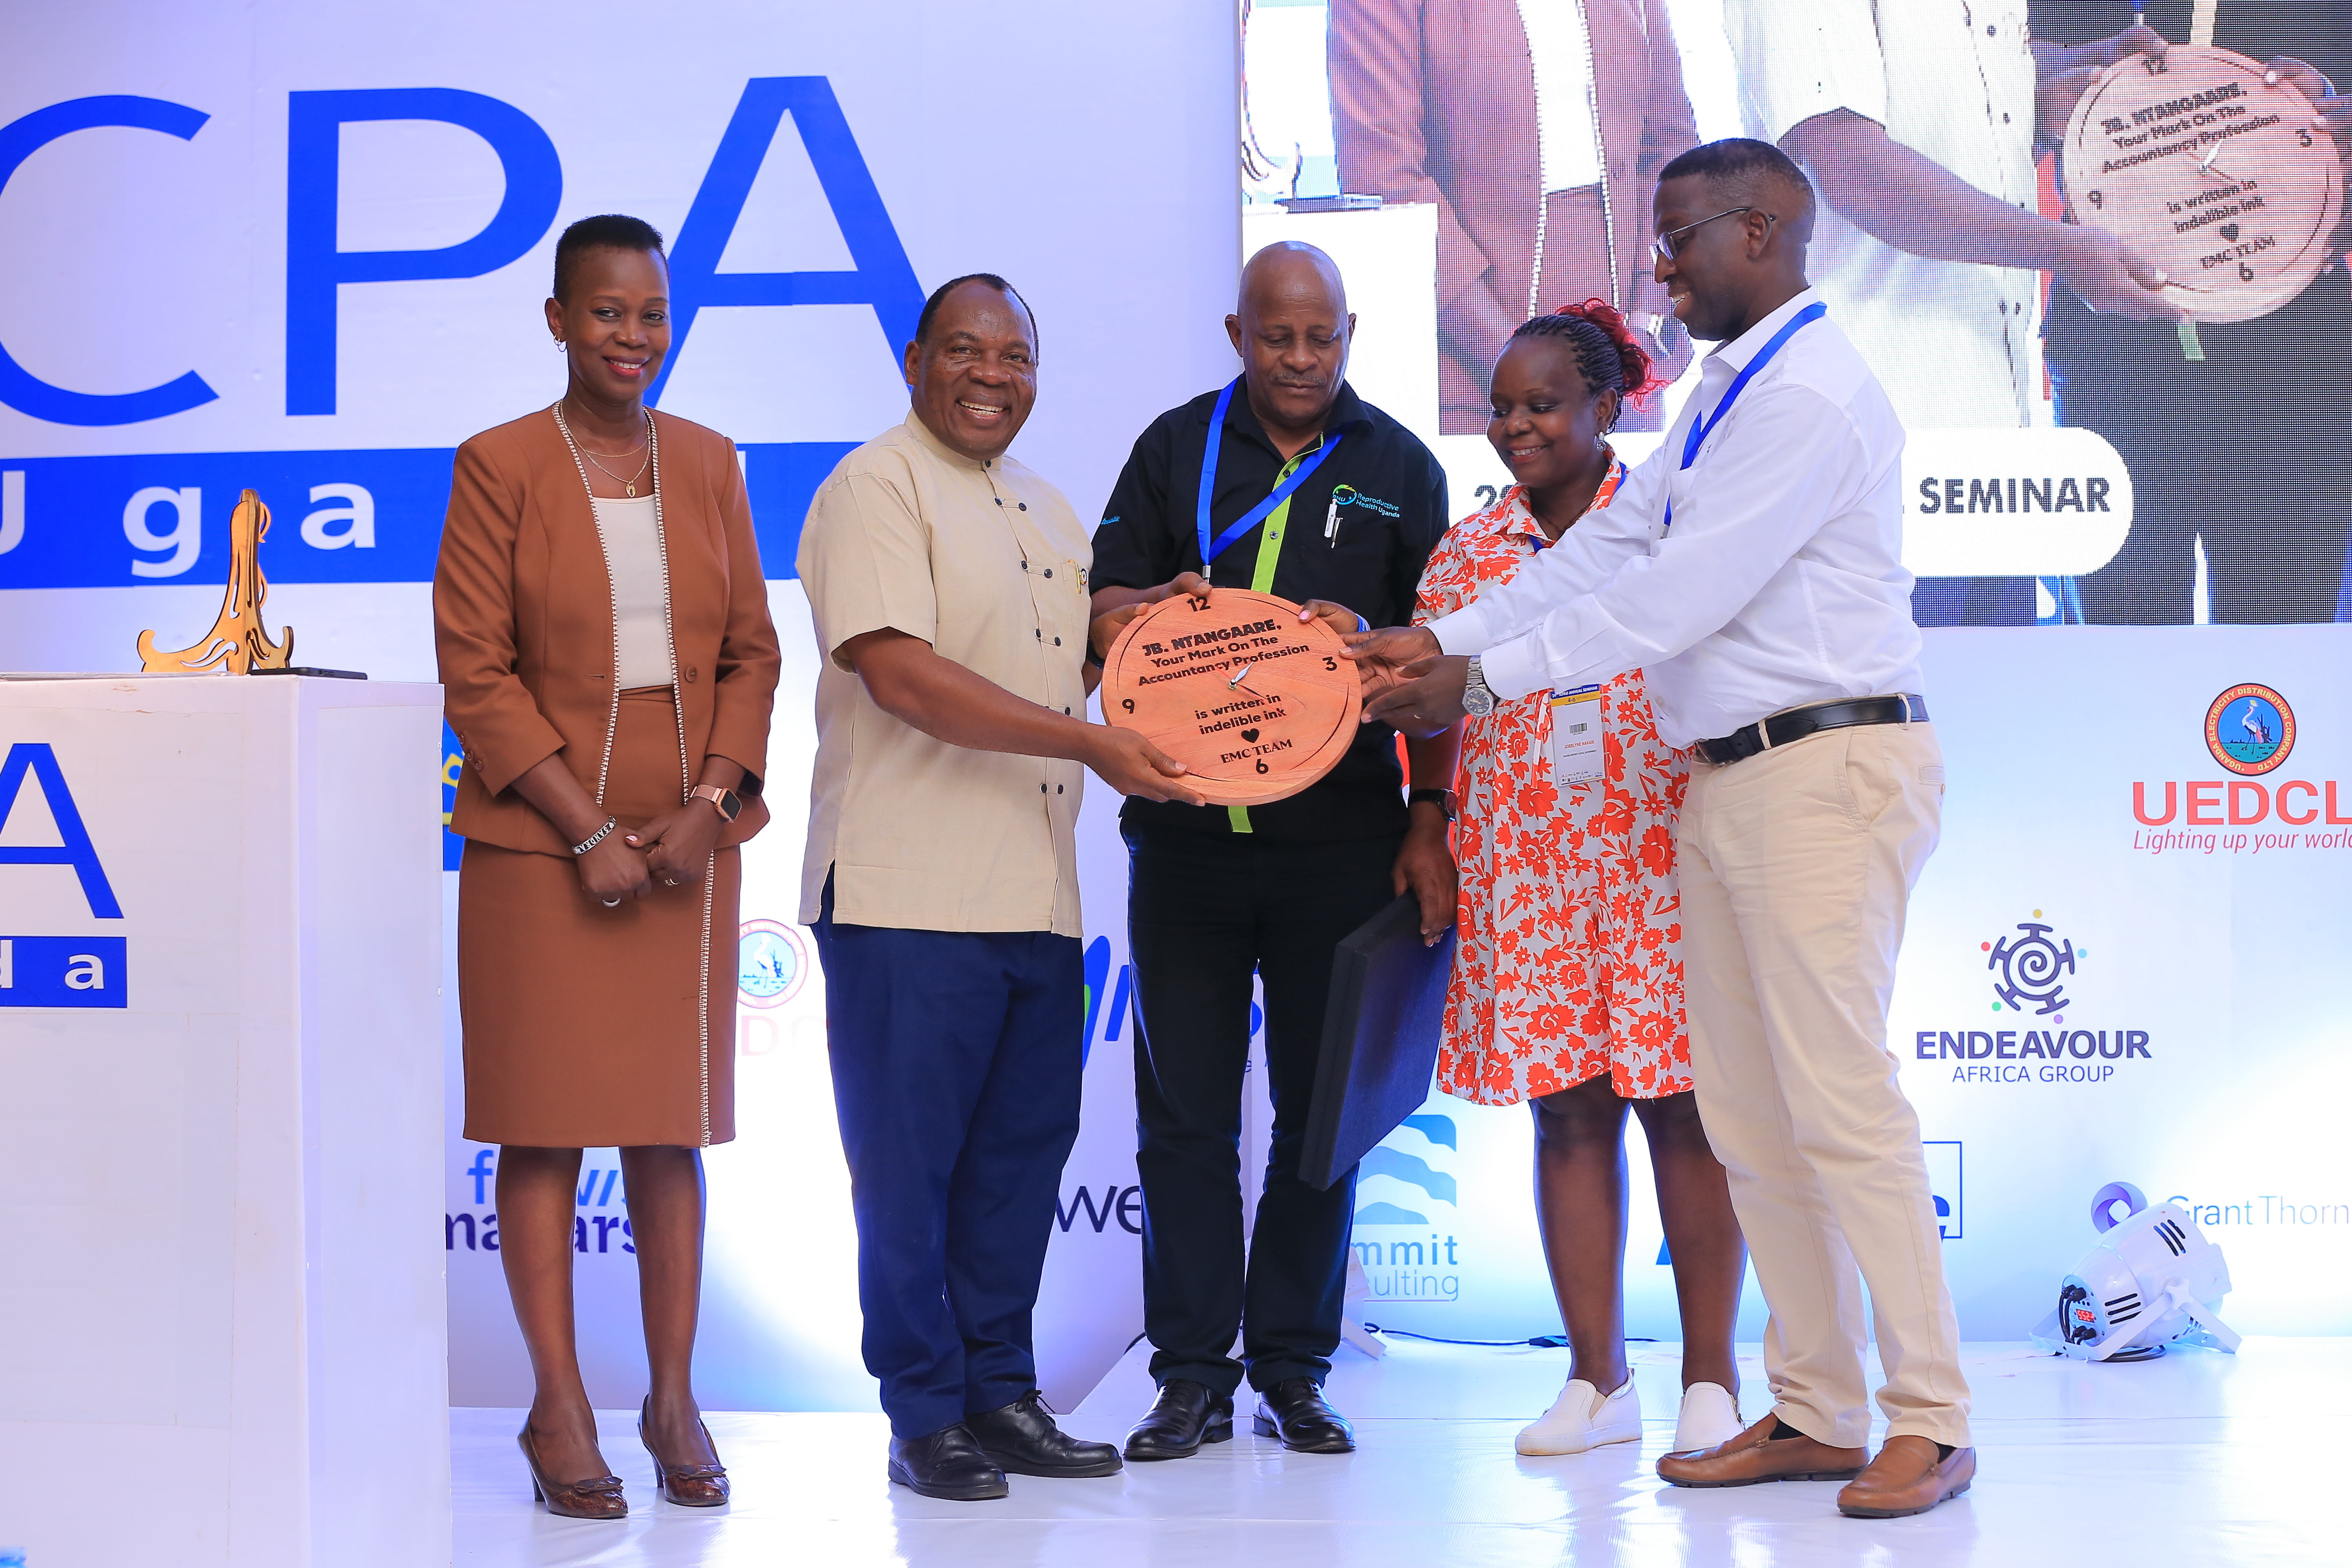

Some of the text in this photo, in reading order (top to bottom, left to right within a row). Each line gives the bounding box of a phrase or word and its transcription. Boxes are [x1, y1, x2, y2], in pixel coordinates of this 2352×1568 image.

[2142, 56, 2167, 75] 12
[2101, 117, 2131, 135] JB.
[2114, 106, 2245, 148] Your Mark On The
[2296, 129, 2312, 147] 3
[2103, 114, 2280, 172] Accountancy Profession
[2088, 191, 2102, 209] 9
[2167, 180, 2257, 214] is written in
[2174, 196, 2265, 233] indelible ink
[0, 76, 927, 427] CPA
[2201, 236, 2275, 268] EMC TEAM
[2239, 263, 2254, 281] 6
[1356, 499, 1400, 518] Health Uganda
[1358, 493, 1399, 511] Reproductive
[1920, 477, 2110, 514] SEMINAR
[1187, 596, 1211, 611] 12
[1143, 619, 1281, 656] JB. NTANGAARE,
[1151, 635, 1278, 668] Your Mark On The
[1323, 657, 1337, 671] 3
[1139, 644, 1310, 686] Accountancy Profession
[1122, 699, 1135, 714] 9
[1195, 694, 1281, 719] is written in
[1199, 708, 1287, 735] indelible ink
[2209, 687, 2292, 771] UGANDA ELECTRICITY DISTRIBUTION COMPANY LTD
[1221, 739, 1292, 764] EMC TEAM
[1256, 759, 1269, 774] 6
[2133, 780, 2352, 826] UEDCL
[579, 826, 609, 851] SANDRA
[2134, 829, 2216, 855] Lighting
[2224, 834, 2247, 854] up
[2252, 834, 2299, 854] your
[1916, 1030, 2152, 1059] ENDEAVOUR
[1952, 1065, 2114, 1082] AFRICA GROUP
[2258, 1196, 2349, 1225] Thorn
[1374, 1270, 1459, 1302] ulting
